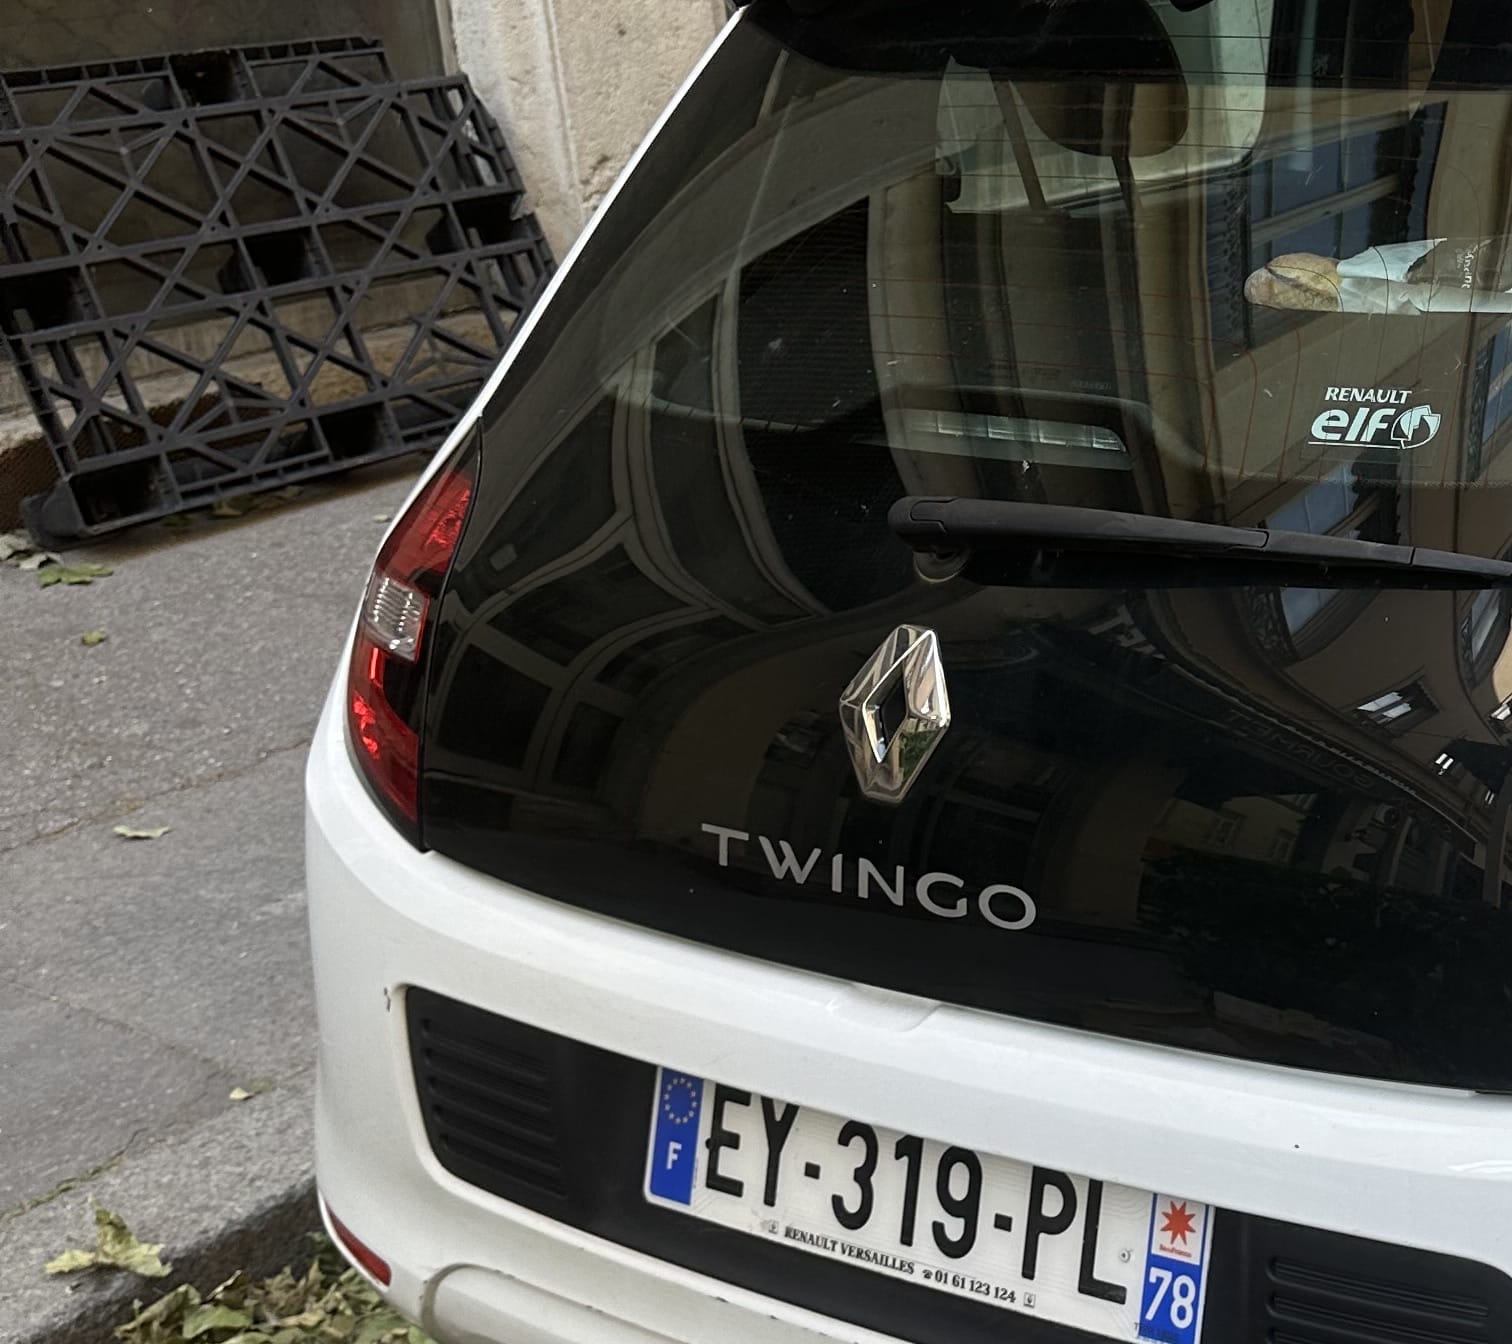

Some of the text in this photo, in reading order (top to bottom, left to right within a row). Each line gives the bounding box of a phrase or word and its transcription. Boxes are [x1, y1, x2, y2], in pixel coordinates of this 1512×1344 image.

[1310, 407, 1397, 443] elf
[1324, 386, 1413, 404] RENAULT
[701, 822, 1037, 930] TWINGO
[666, 1141, 682, 1170] F
[705, 1083, 1127, 1305] EY-319-PL
[784, 1226, 1017, 1304] RENAULT VERSAILLES 01 61 123 124
[1145, 1266, 1196, 1329] 78
